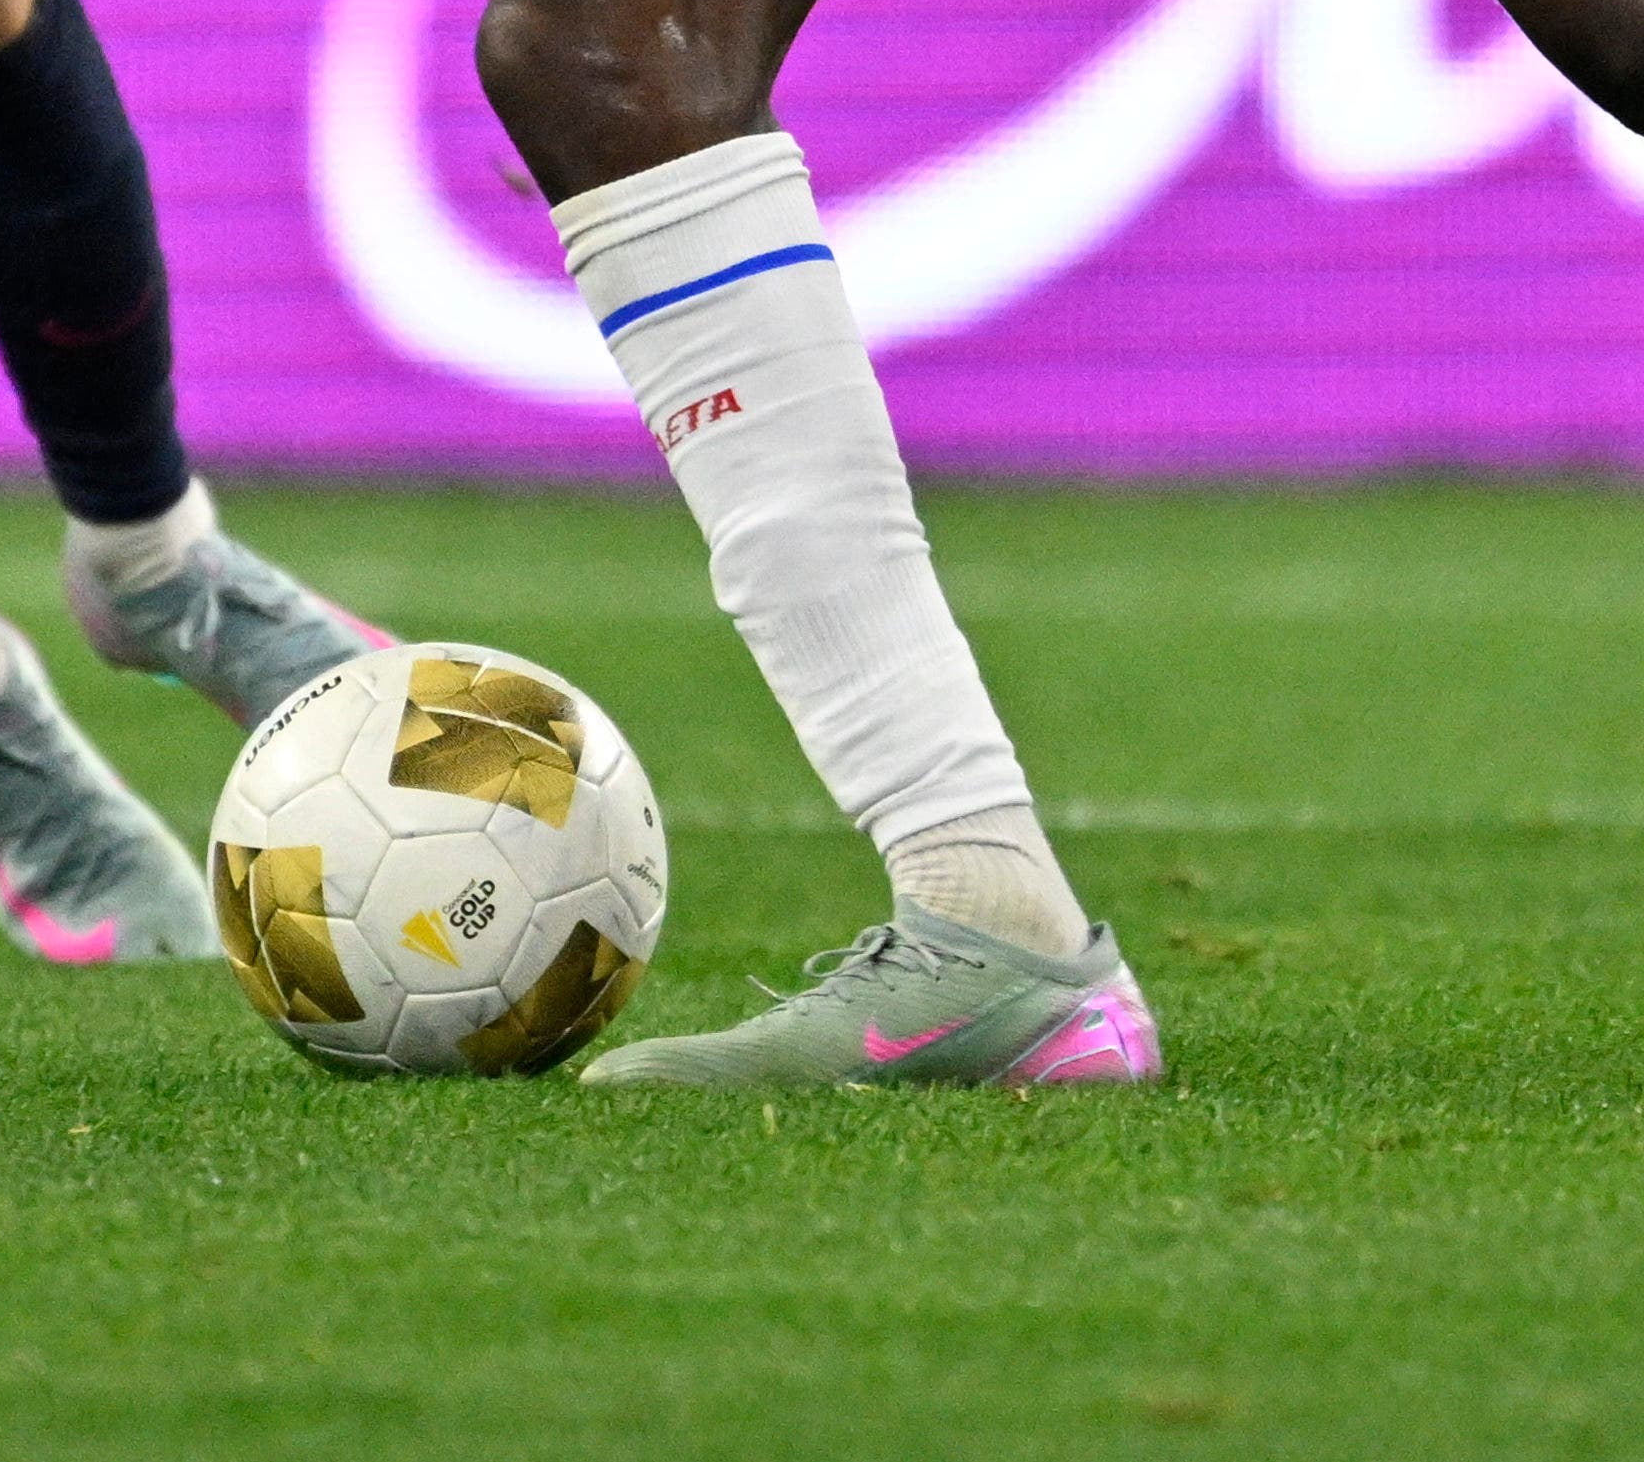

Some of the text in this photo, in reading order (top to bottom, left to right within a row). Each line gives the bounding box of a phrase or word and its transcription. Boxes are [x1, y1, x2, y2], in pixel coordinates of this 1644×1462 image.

[244, 675, 343, 768] molten
[449, 879, 496, 928] GOLD
[462, 903, 496, 940] CUP
